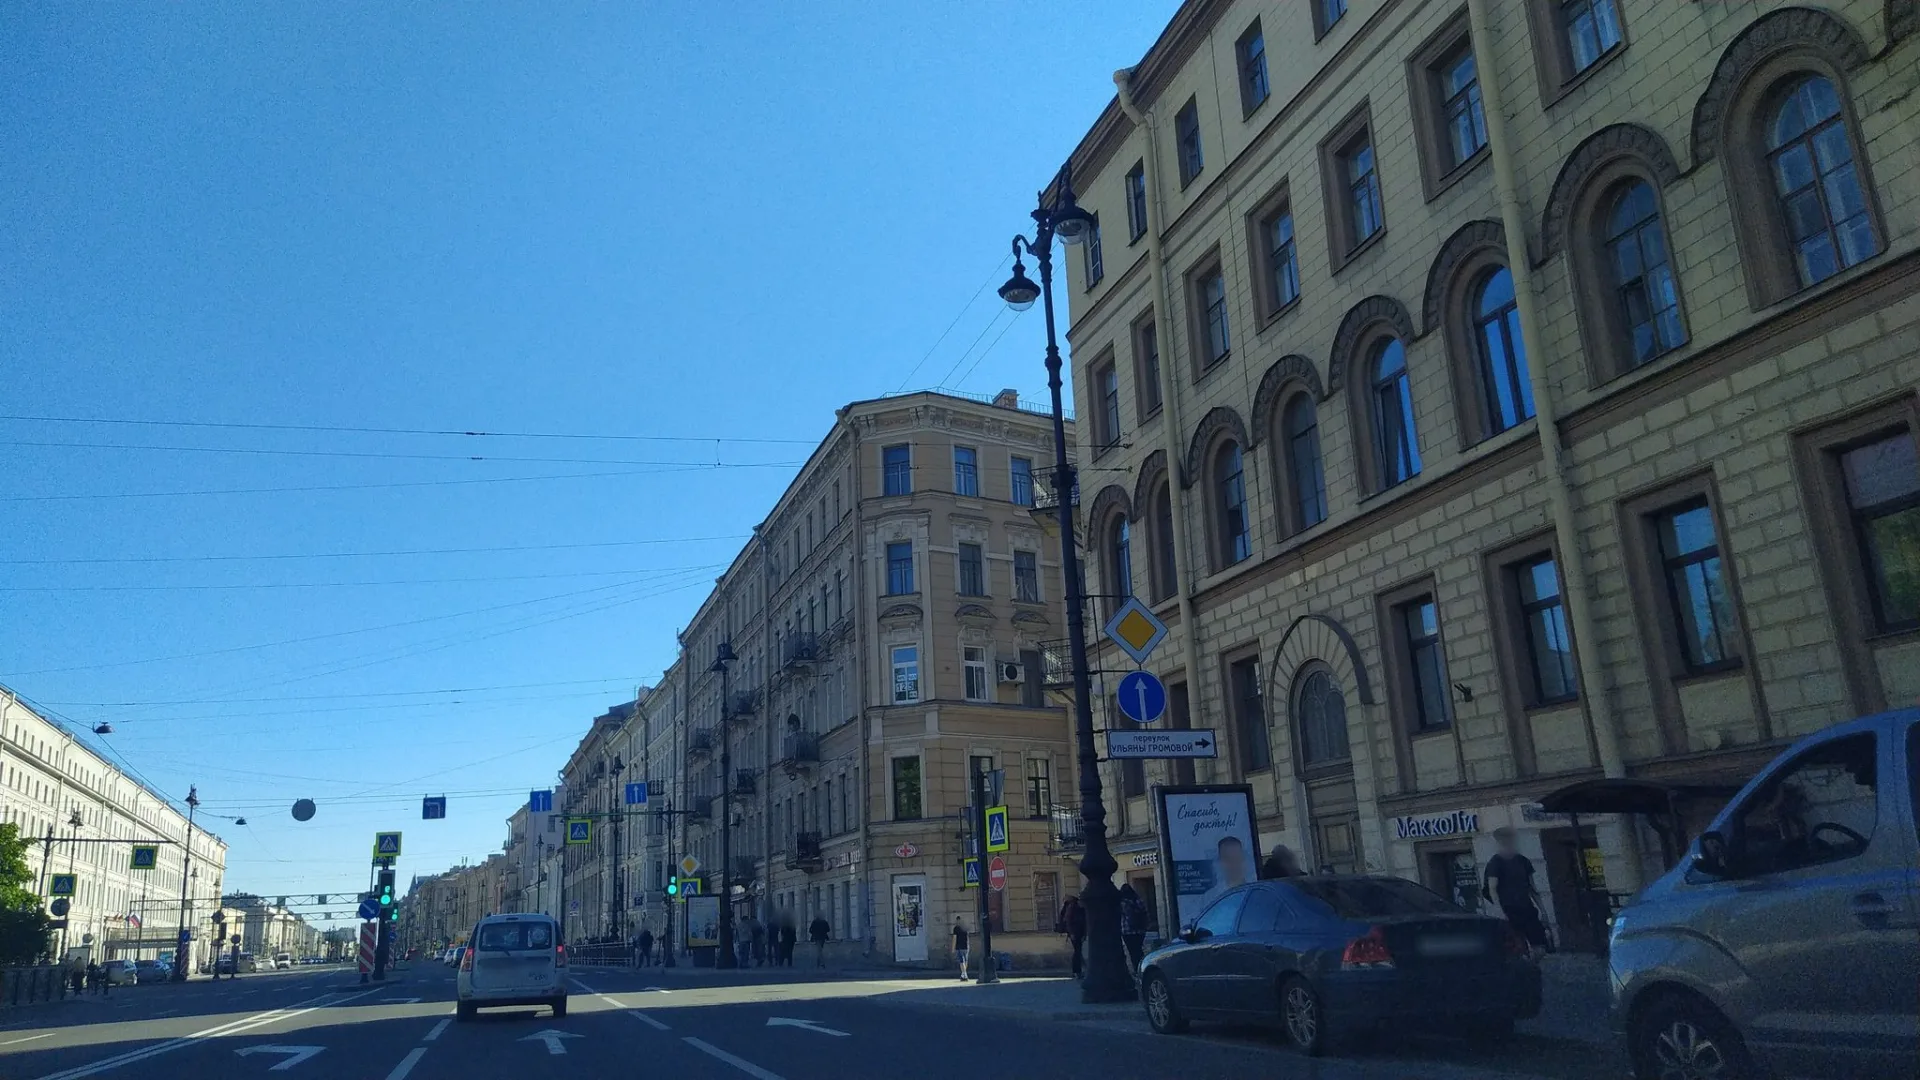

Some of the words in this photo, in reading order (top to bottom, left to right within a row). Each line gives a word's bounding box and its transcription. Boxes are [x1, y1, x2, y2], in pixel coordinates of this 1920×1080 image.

[1133, 735, 1170, 744] переулок
[1111, 743, 1146, 753] УЛЬЯНЫ
[1148, 742, 1193, 752] ГРОМОВОЙ
[1177, 800, 1220, 820] Спасибо,
[1192, 812, 1237, 837] доктор!
[1132, 852, 1158, 867] COFFEE
